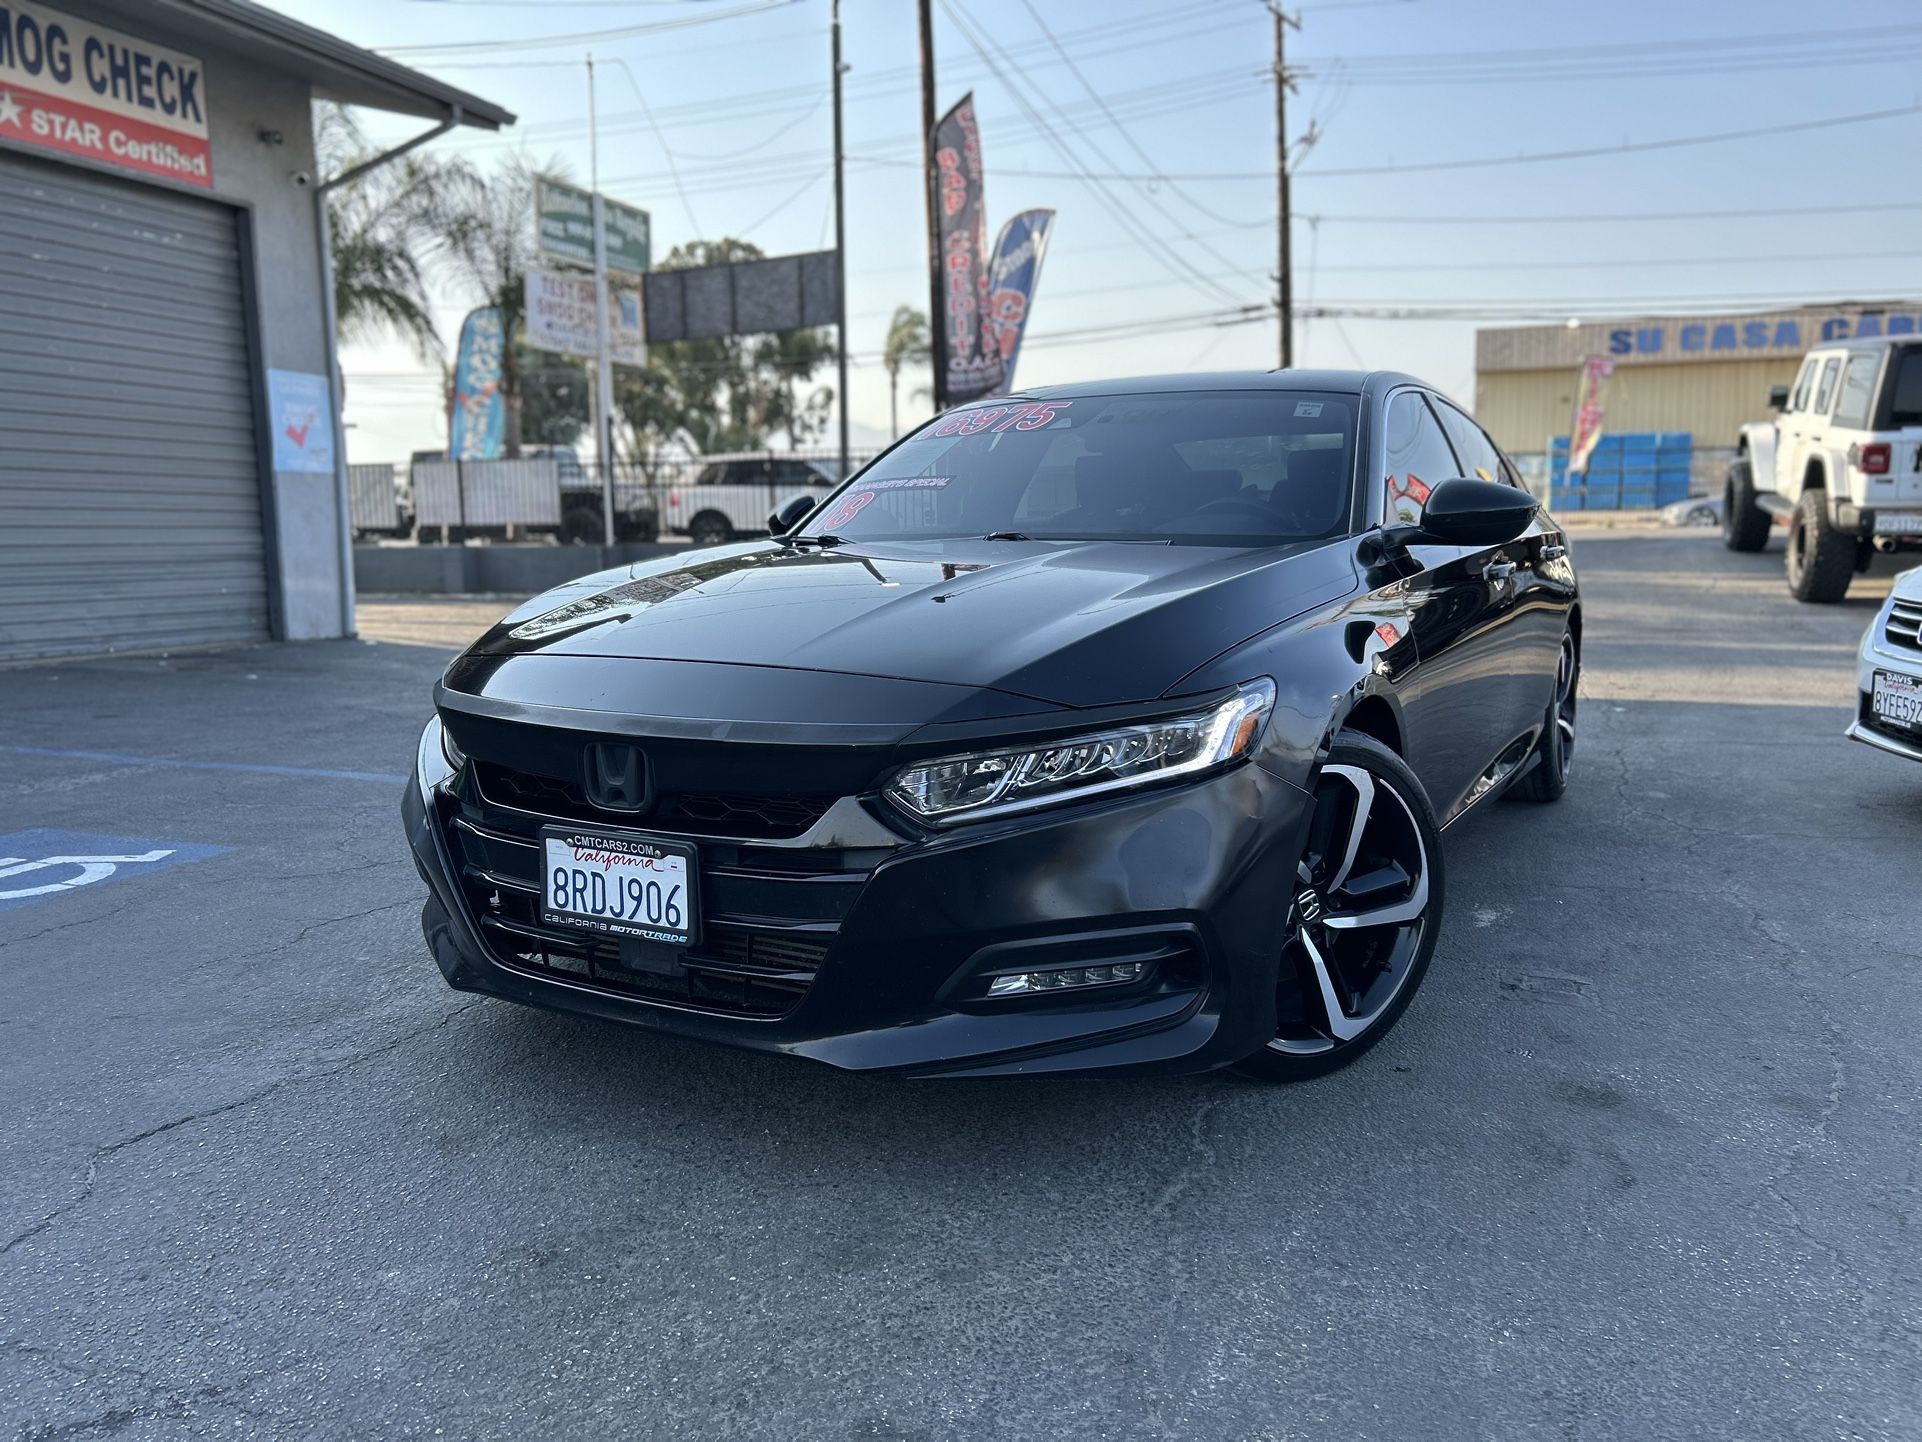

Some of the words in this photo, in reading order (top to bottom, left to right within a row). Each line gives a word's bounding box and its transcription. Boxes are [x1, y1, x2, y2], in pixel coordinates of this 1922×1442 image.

[84, 36, 203, 124] CHECK
[31, 104, 103, 150] STAR
[108, 130, 208, 177] Certified
[1609, 327, 1664, 355] SU
[1680, 320, 1800, 351] CASA
[1886, 673, 1913, 685] DAVIS
[573, 847, 665, 872] California
[574, 835, 654, 856] CMTCARS2.COM
[553, 867, 681, 928] 8RDJ906
